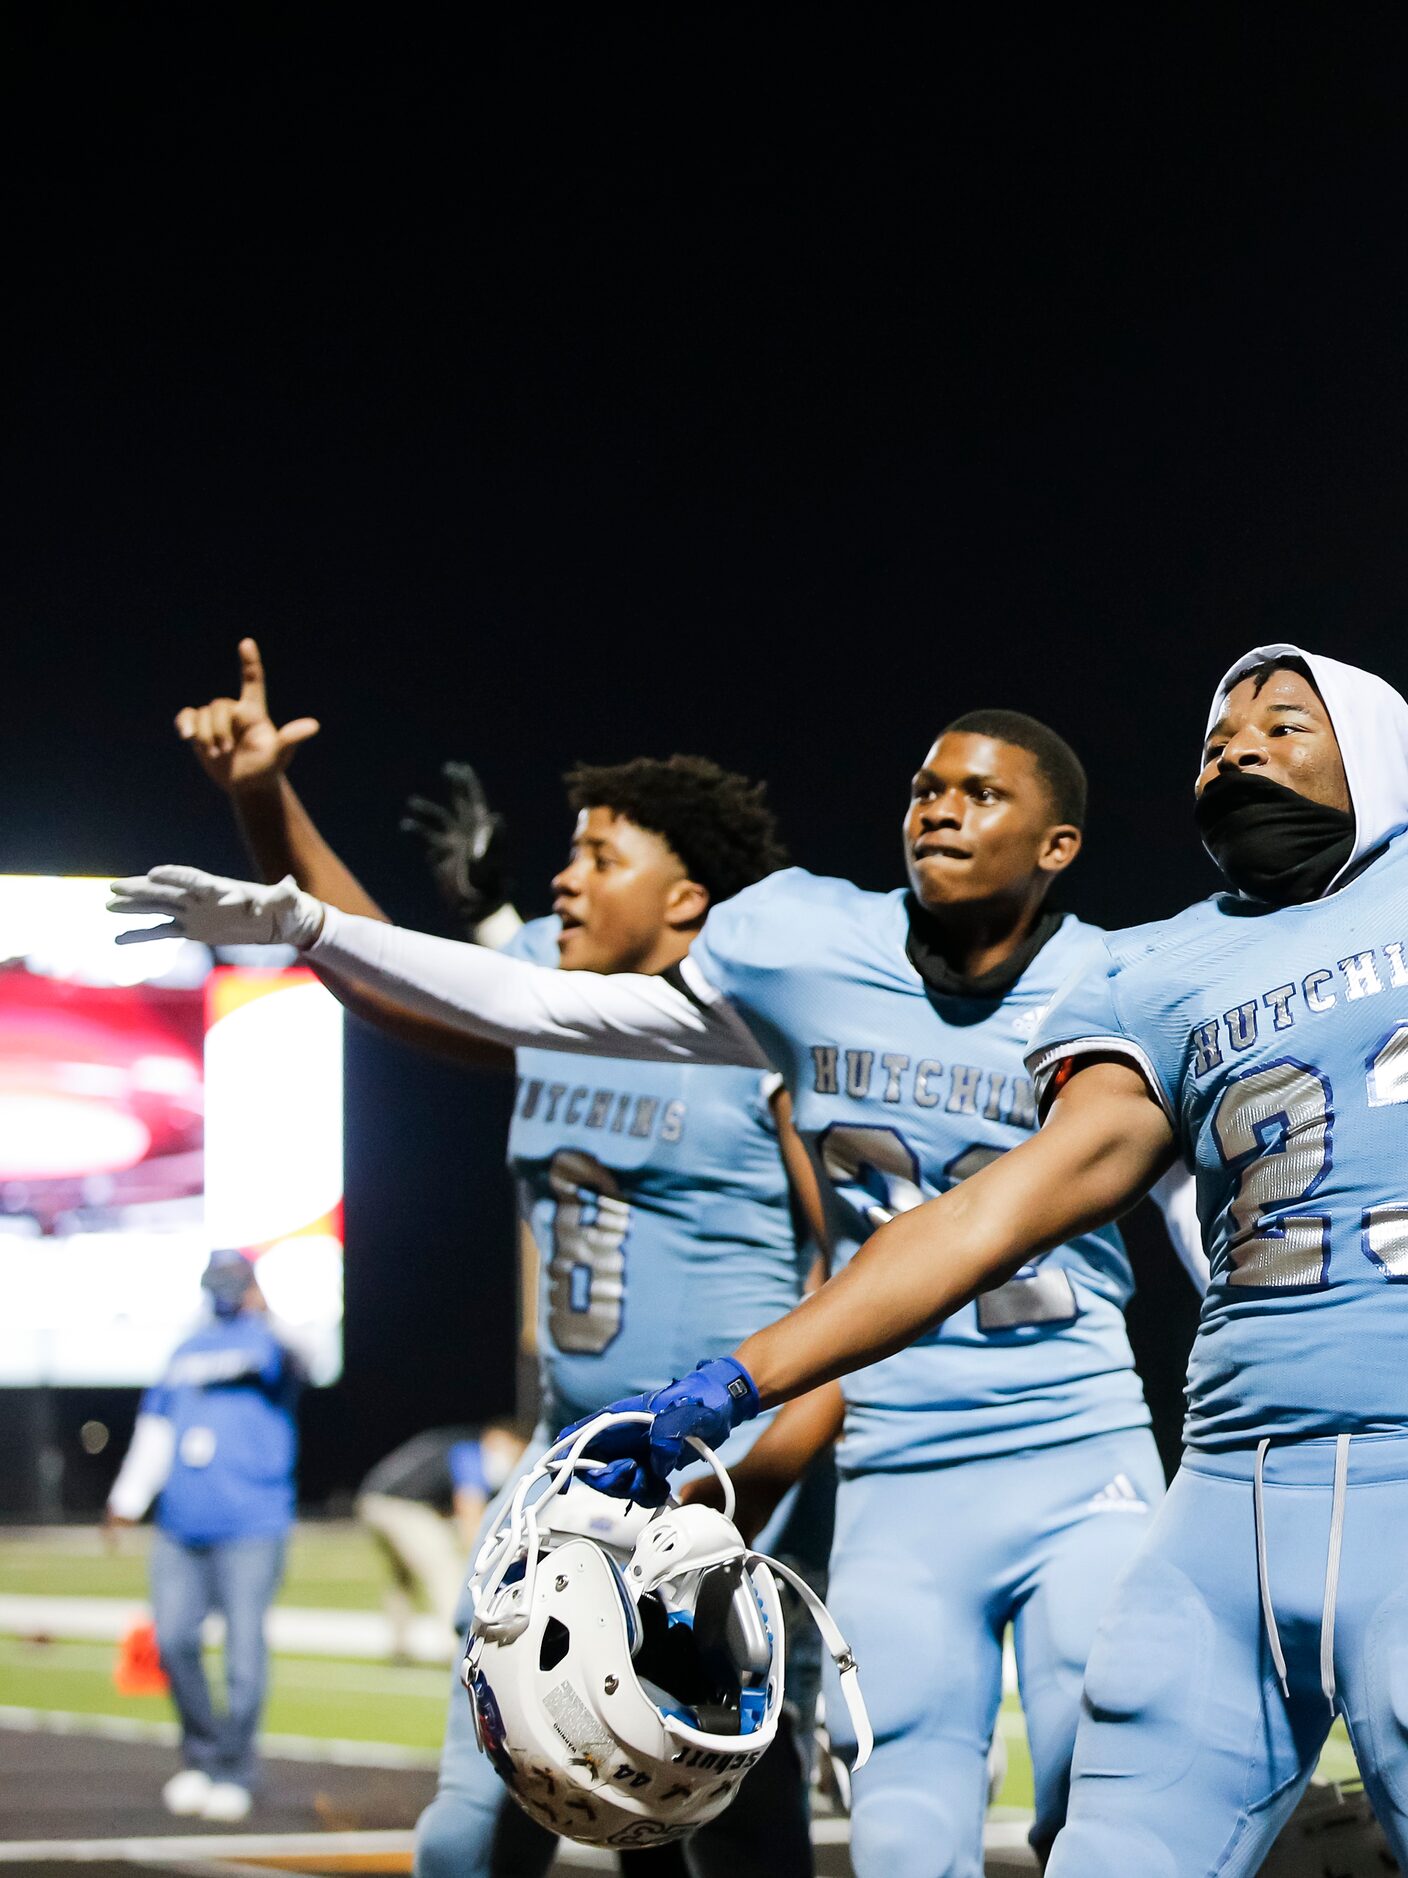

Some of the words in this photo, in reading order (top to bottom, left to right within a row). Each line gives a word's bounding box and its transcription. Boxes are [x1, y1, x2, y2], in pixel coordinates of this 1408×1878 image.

[517, 1075, 688, 1143] UTCHINS
[548, 1147, 632, 1357] 8
[553, 1722, 578, 1754] WARNING
[613, 1763, 652, 1789] 44
